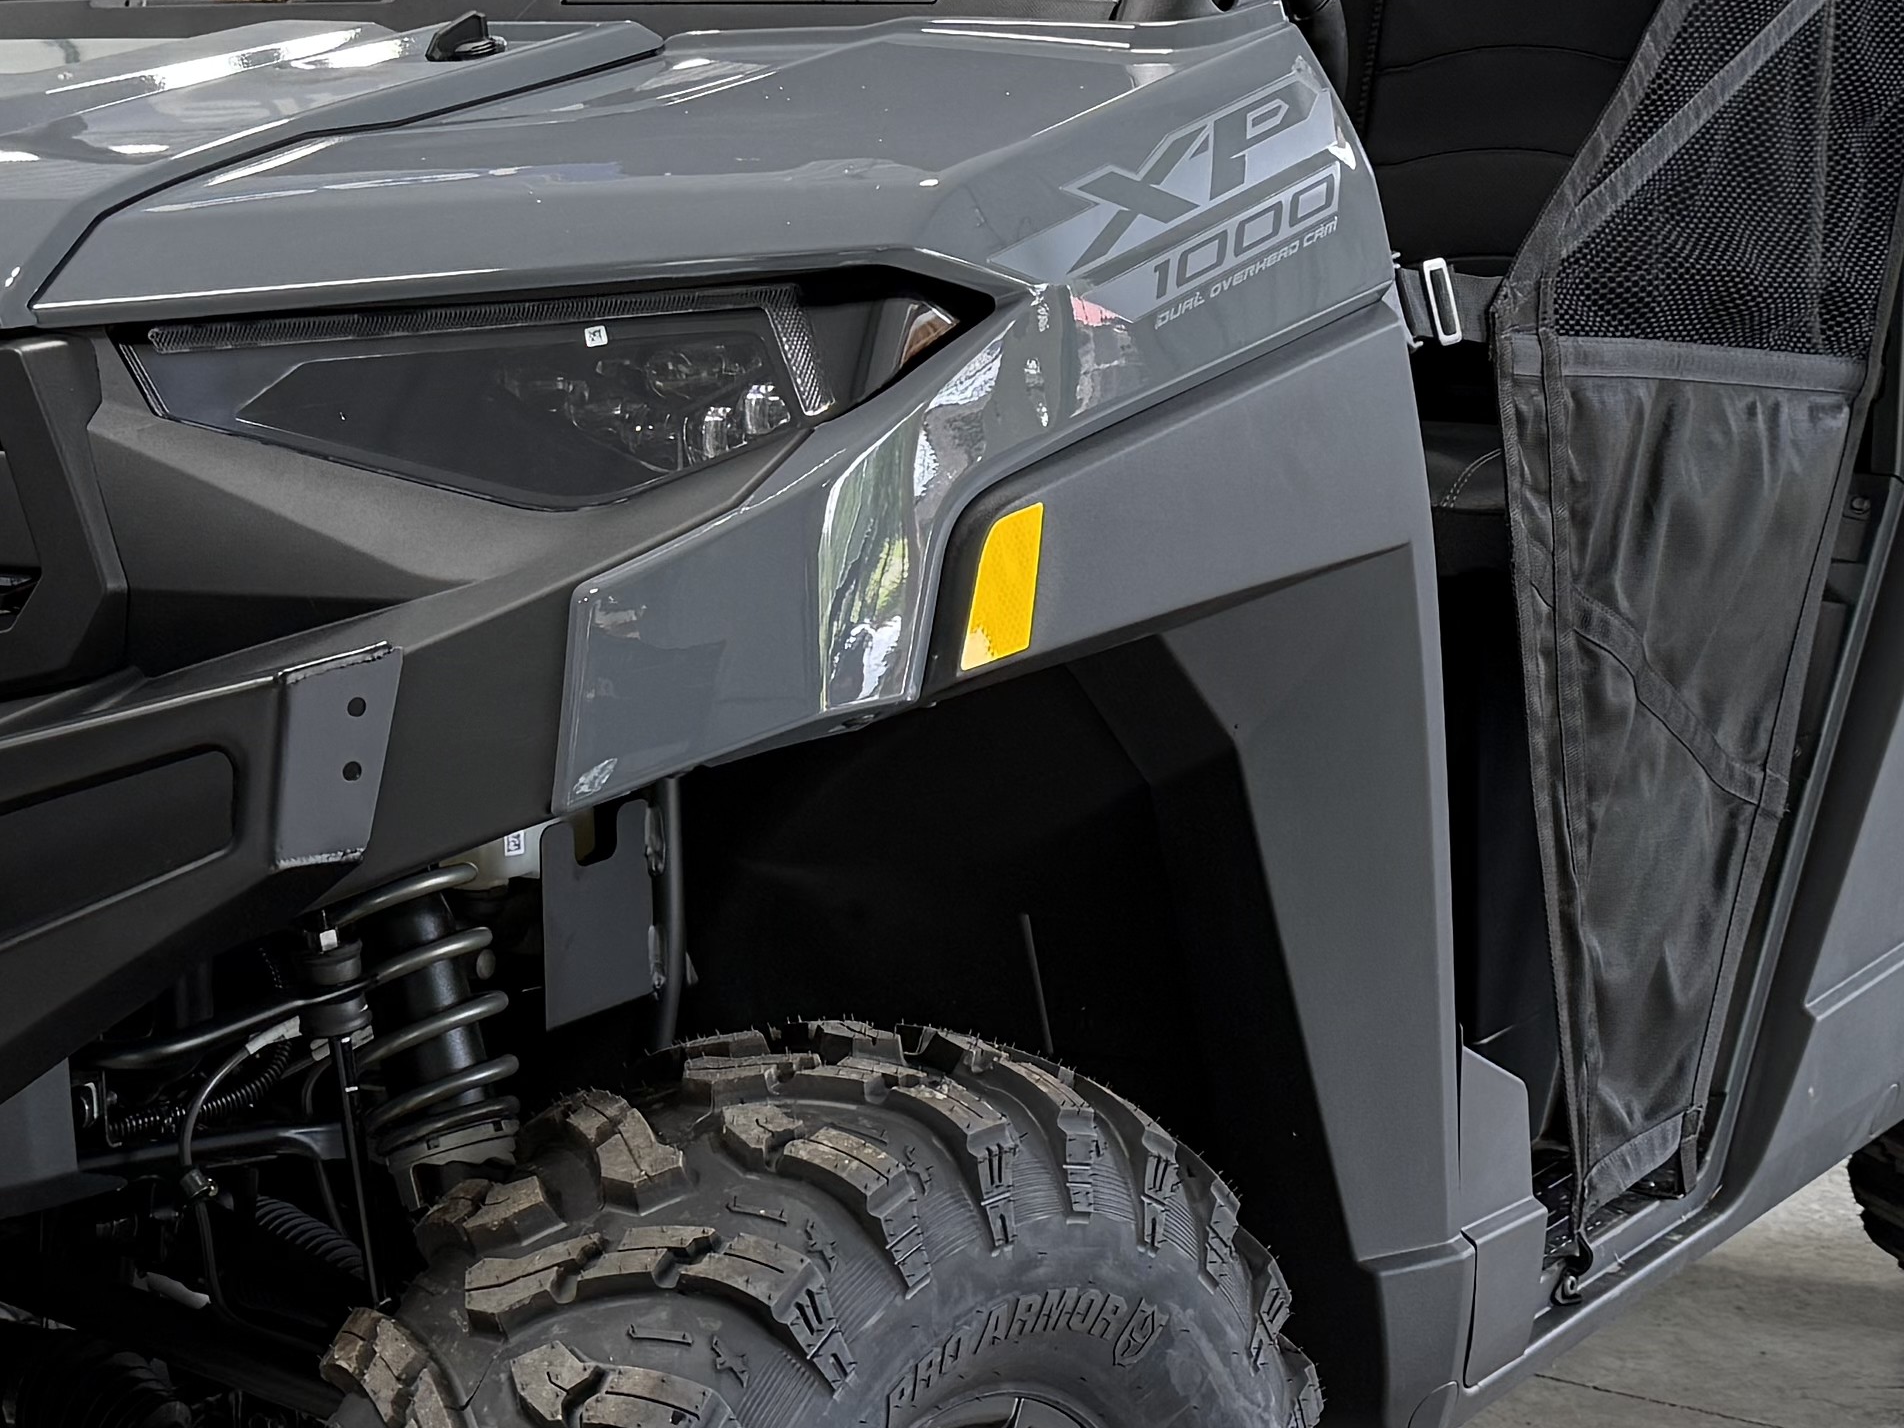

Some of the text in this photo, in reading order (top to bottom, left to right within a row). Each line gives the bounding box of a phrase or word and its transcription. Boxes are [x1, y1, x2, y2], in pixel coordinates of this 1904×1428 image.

[1066, 80, 1320, 274] XP
[1154, 172, 1335, 299] 1000
[1154, 216, 1338, 330] DUAL OVERHEAD CAM
[973, 1287, 1128, 1355] ARMOR
